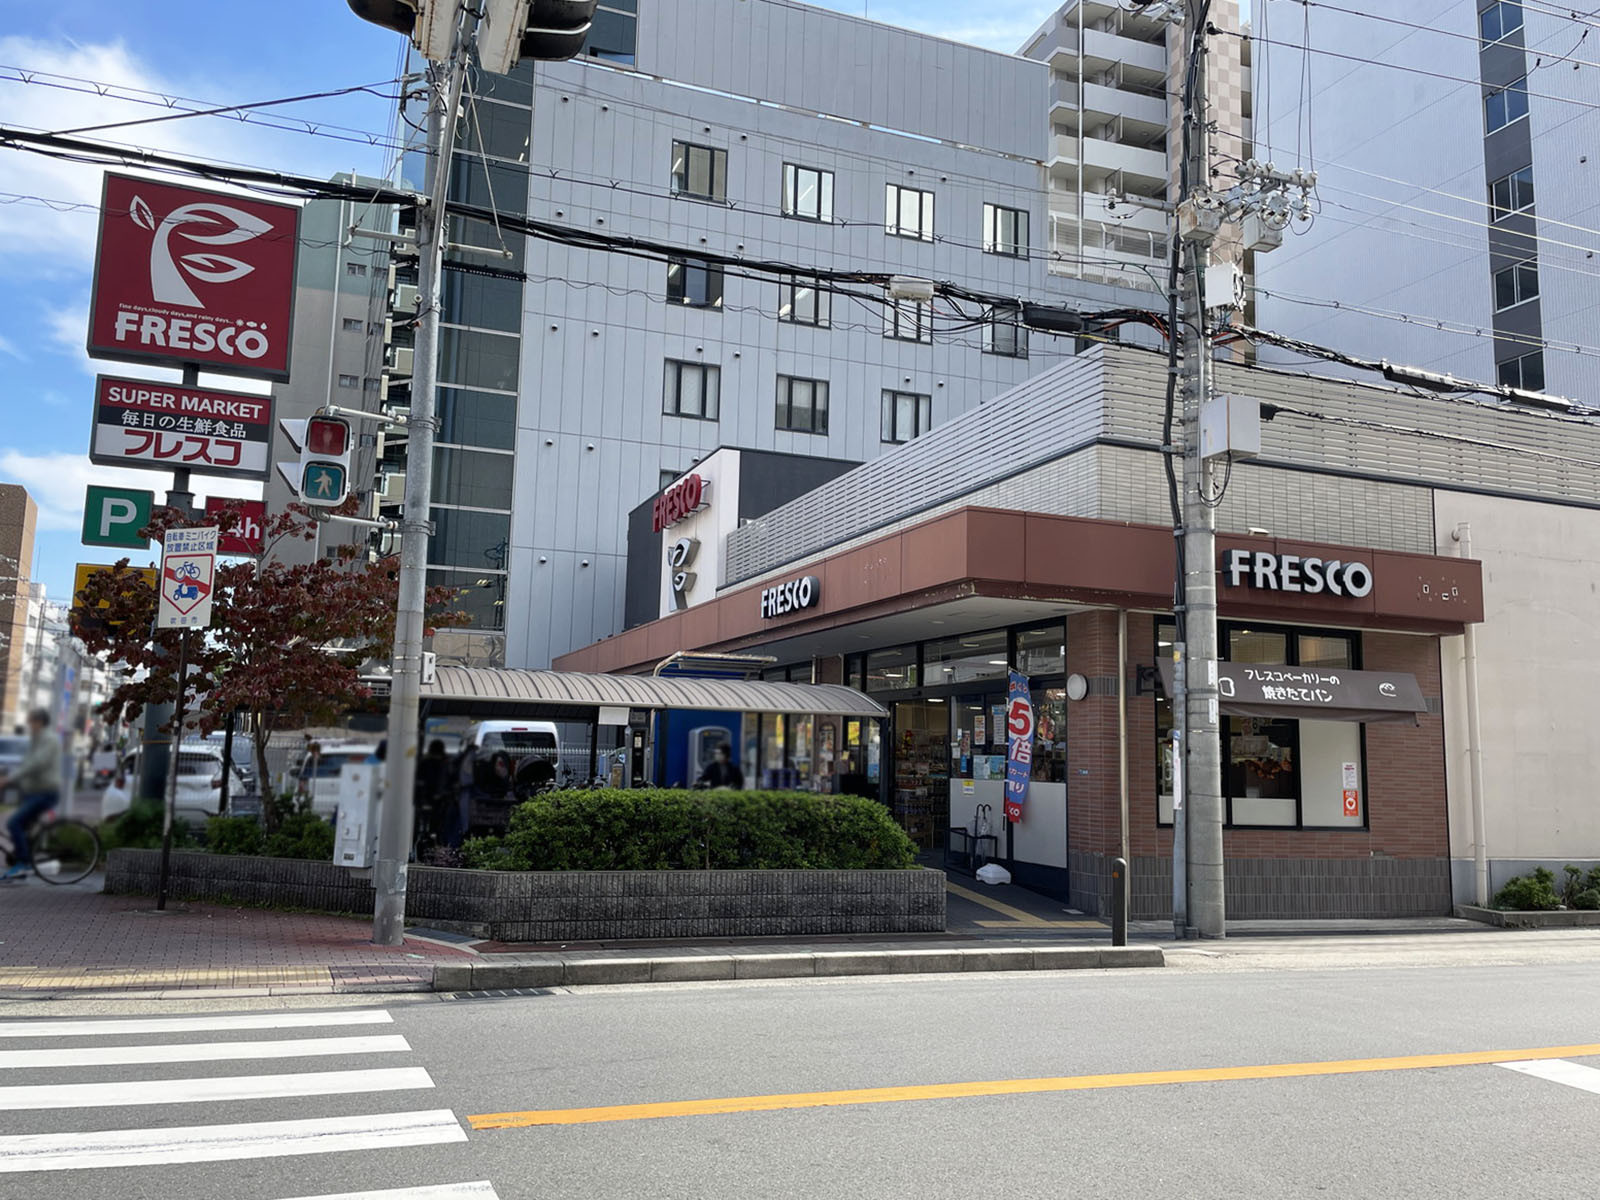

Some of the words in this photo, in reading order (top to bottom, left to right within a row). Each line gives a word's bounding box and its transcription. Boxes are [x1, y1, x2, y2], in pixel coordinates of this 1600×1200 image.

[115, 311, 269, 358] FRESCO
[108, 387, 176, 409] SUPER
[181, 396, 263, 419] MARKET
[121, 409, 246, 438] 毎日の生鮮食品
[124, 428, 242, 466] フレスコ
[100, 497, 137, 537] P
[653, 473, 702, 533] FRESCO
[1229, 549, 1373, 598] FRESCO
[760, 576, 815, 619] FRESCO
[1244, 669, 1340, 685] フレスコベーカリーの
[1261, 685, 1333, 702] 焼きたてパン
